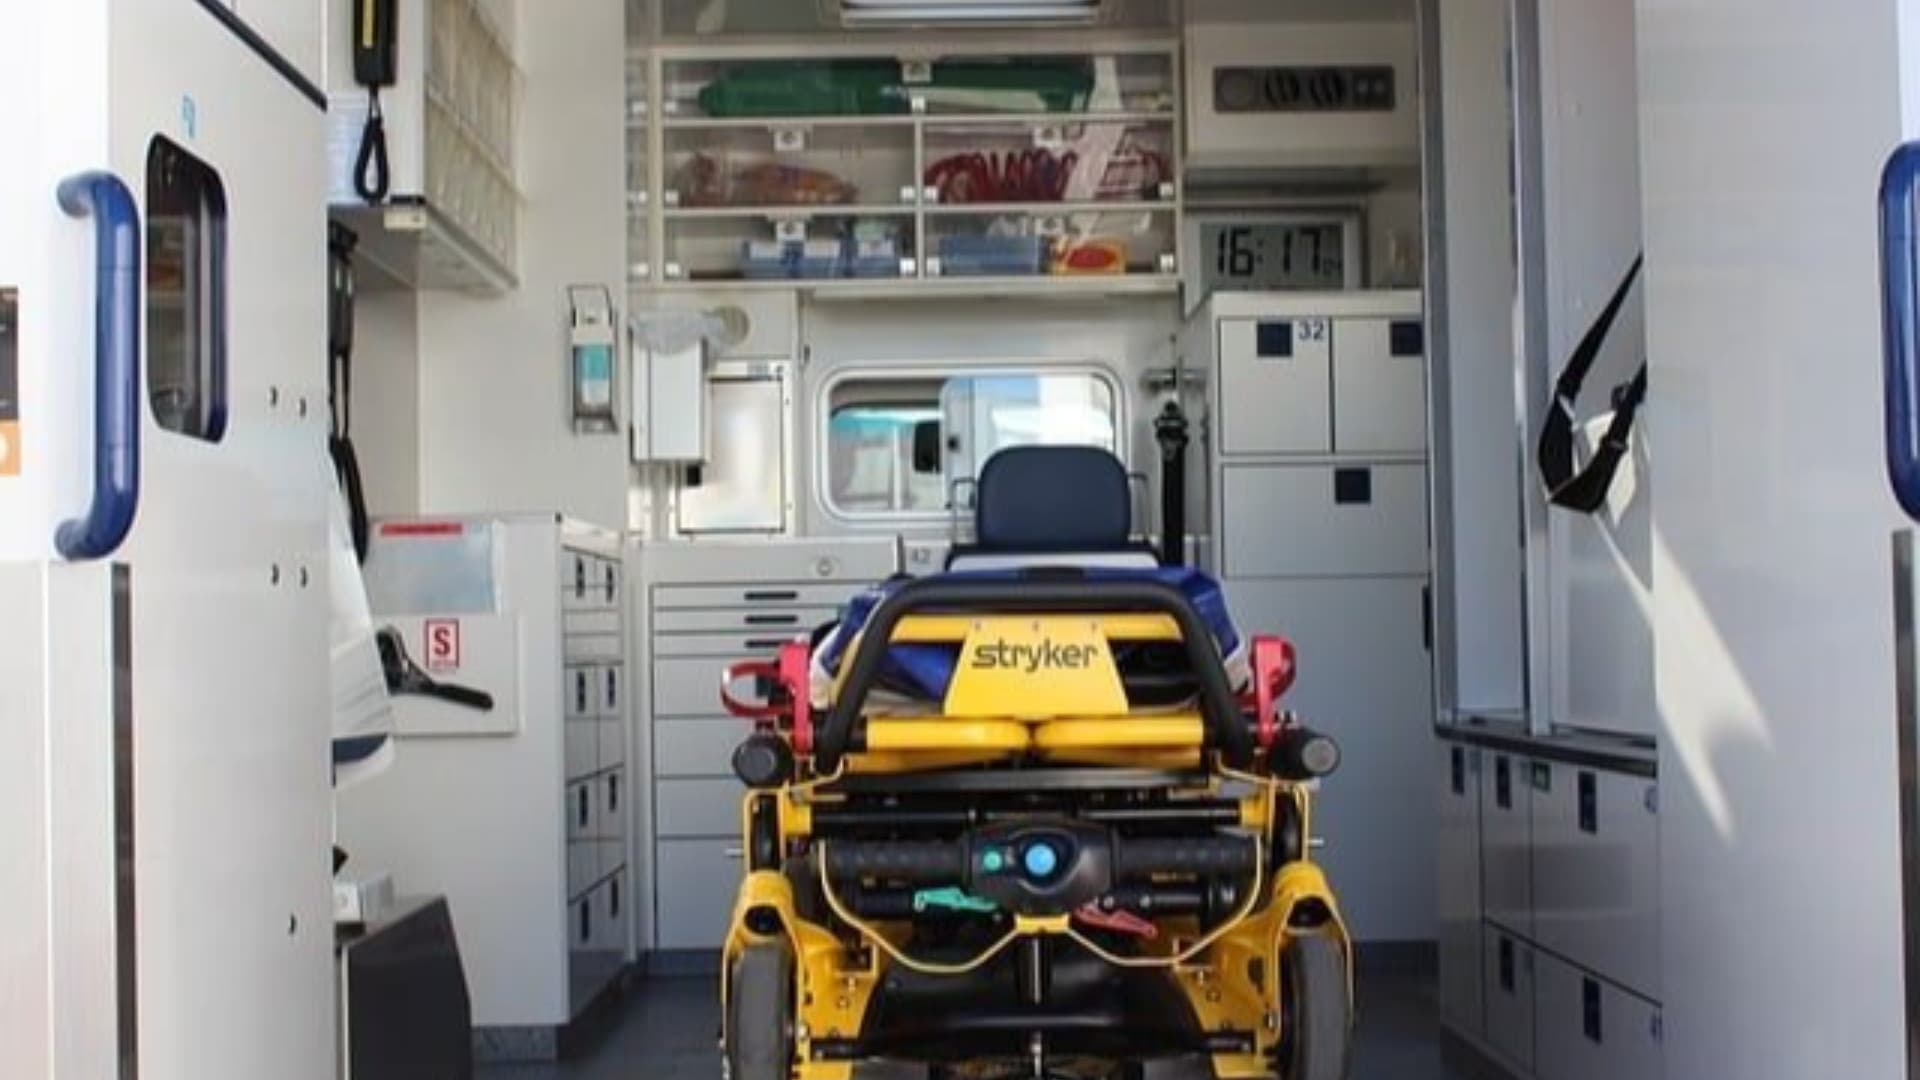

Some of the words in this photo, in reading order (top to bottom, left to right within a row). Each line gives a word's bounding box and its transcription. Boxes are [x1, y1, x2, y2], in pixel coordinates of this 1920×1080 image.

[1217, 227, 1321, 276] 16:17
[1299, 319, 1323, 341] 32
[433, 626, 451, 657] S
[971, 638, 1099, 673] stryker
